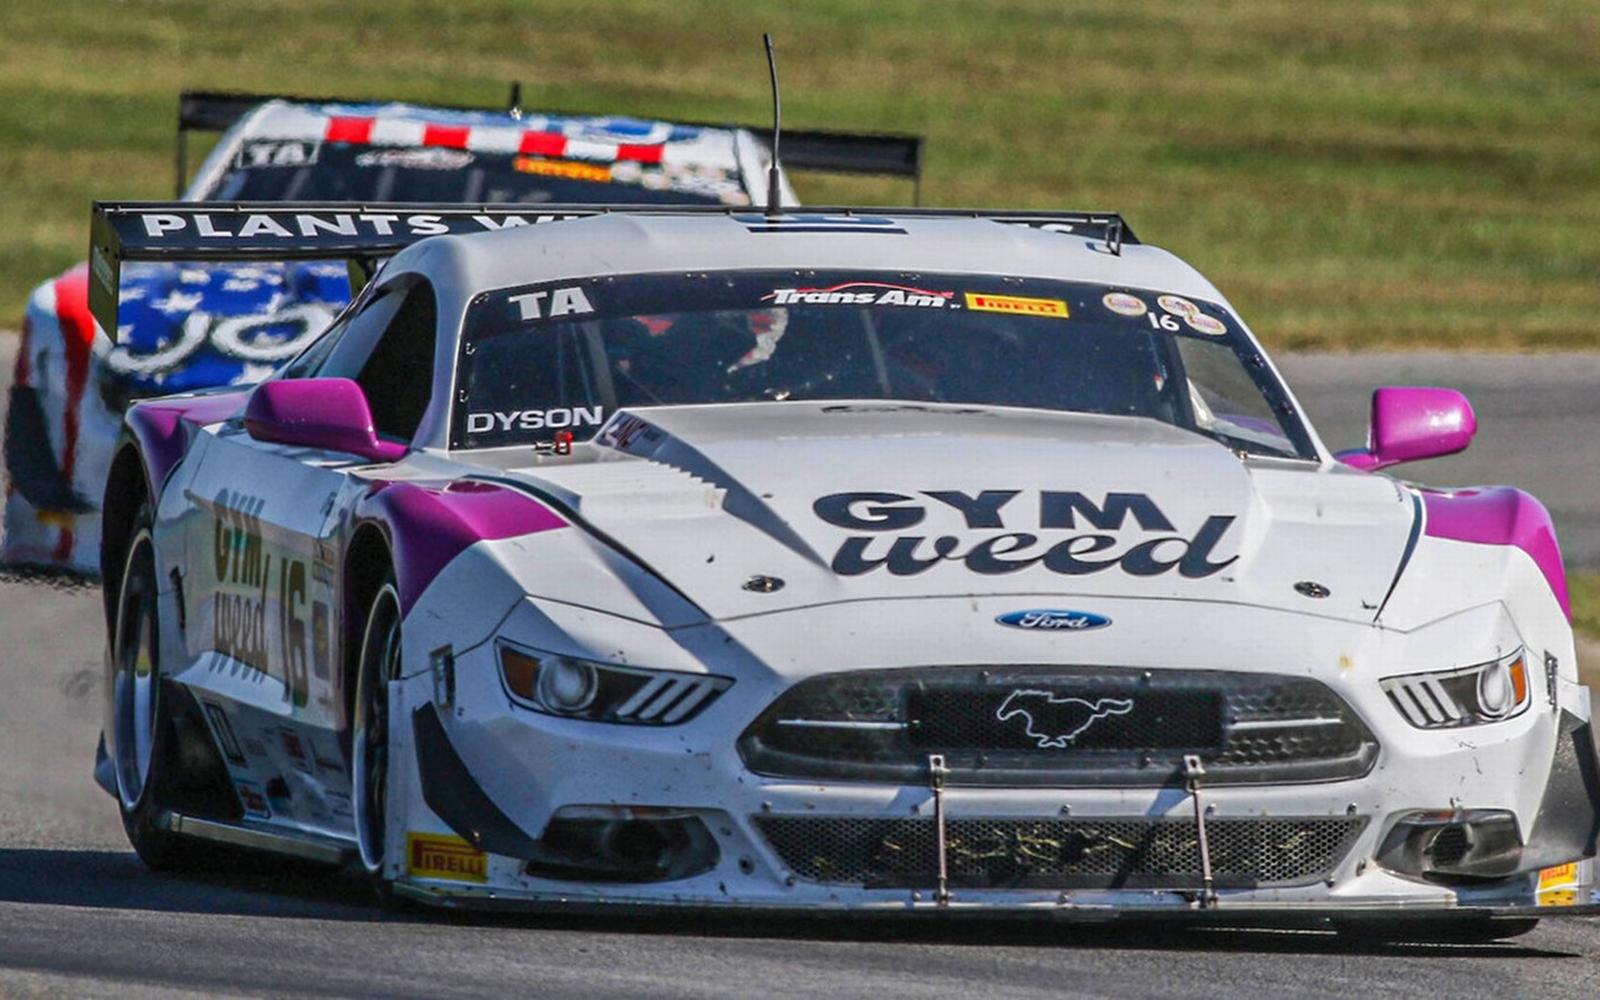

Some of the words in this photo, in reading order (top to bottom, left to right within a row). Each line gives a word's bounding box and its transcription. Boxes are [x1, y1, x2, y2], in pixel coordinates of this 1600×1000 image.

[141, 214, 450, 238] PLANTS
[508, 286, 595, 321] TA
[773, 289, 882, 306] Trans
[884, 290, 947, 308] Am
[1147, 311, 1180, 331] 16
[466, 405, 604, 433] DYSON
[813, 490, 1177, 531] GYM
[830, 515, 1240, 579] weed
[280, 557, 308, 708] 16
[1020, 612, 1089, 630] Ford
[412, 838, 484, 877] PIRELLI
